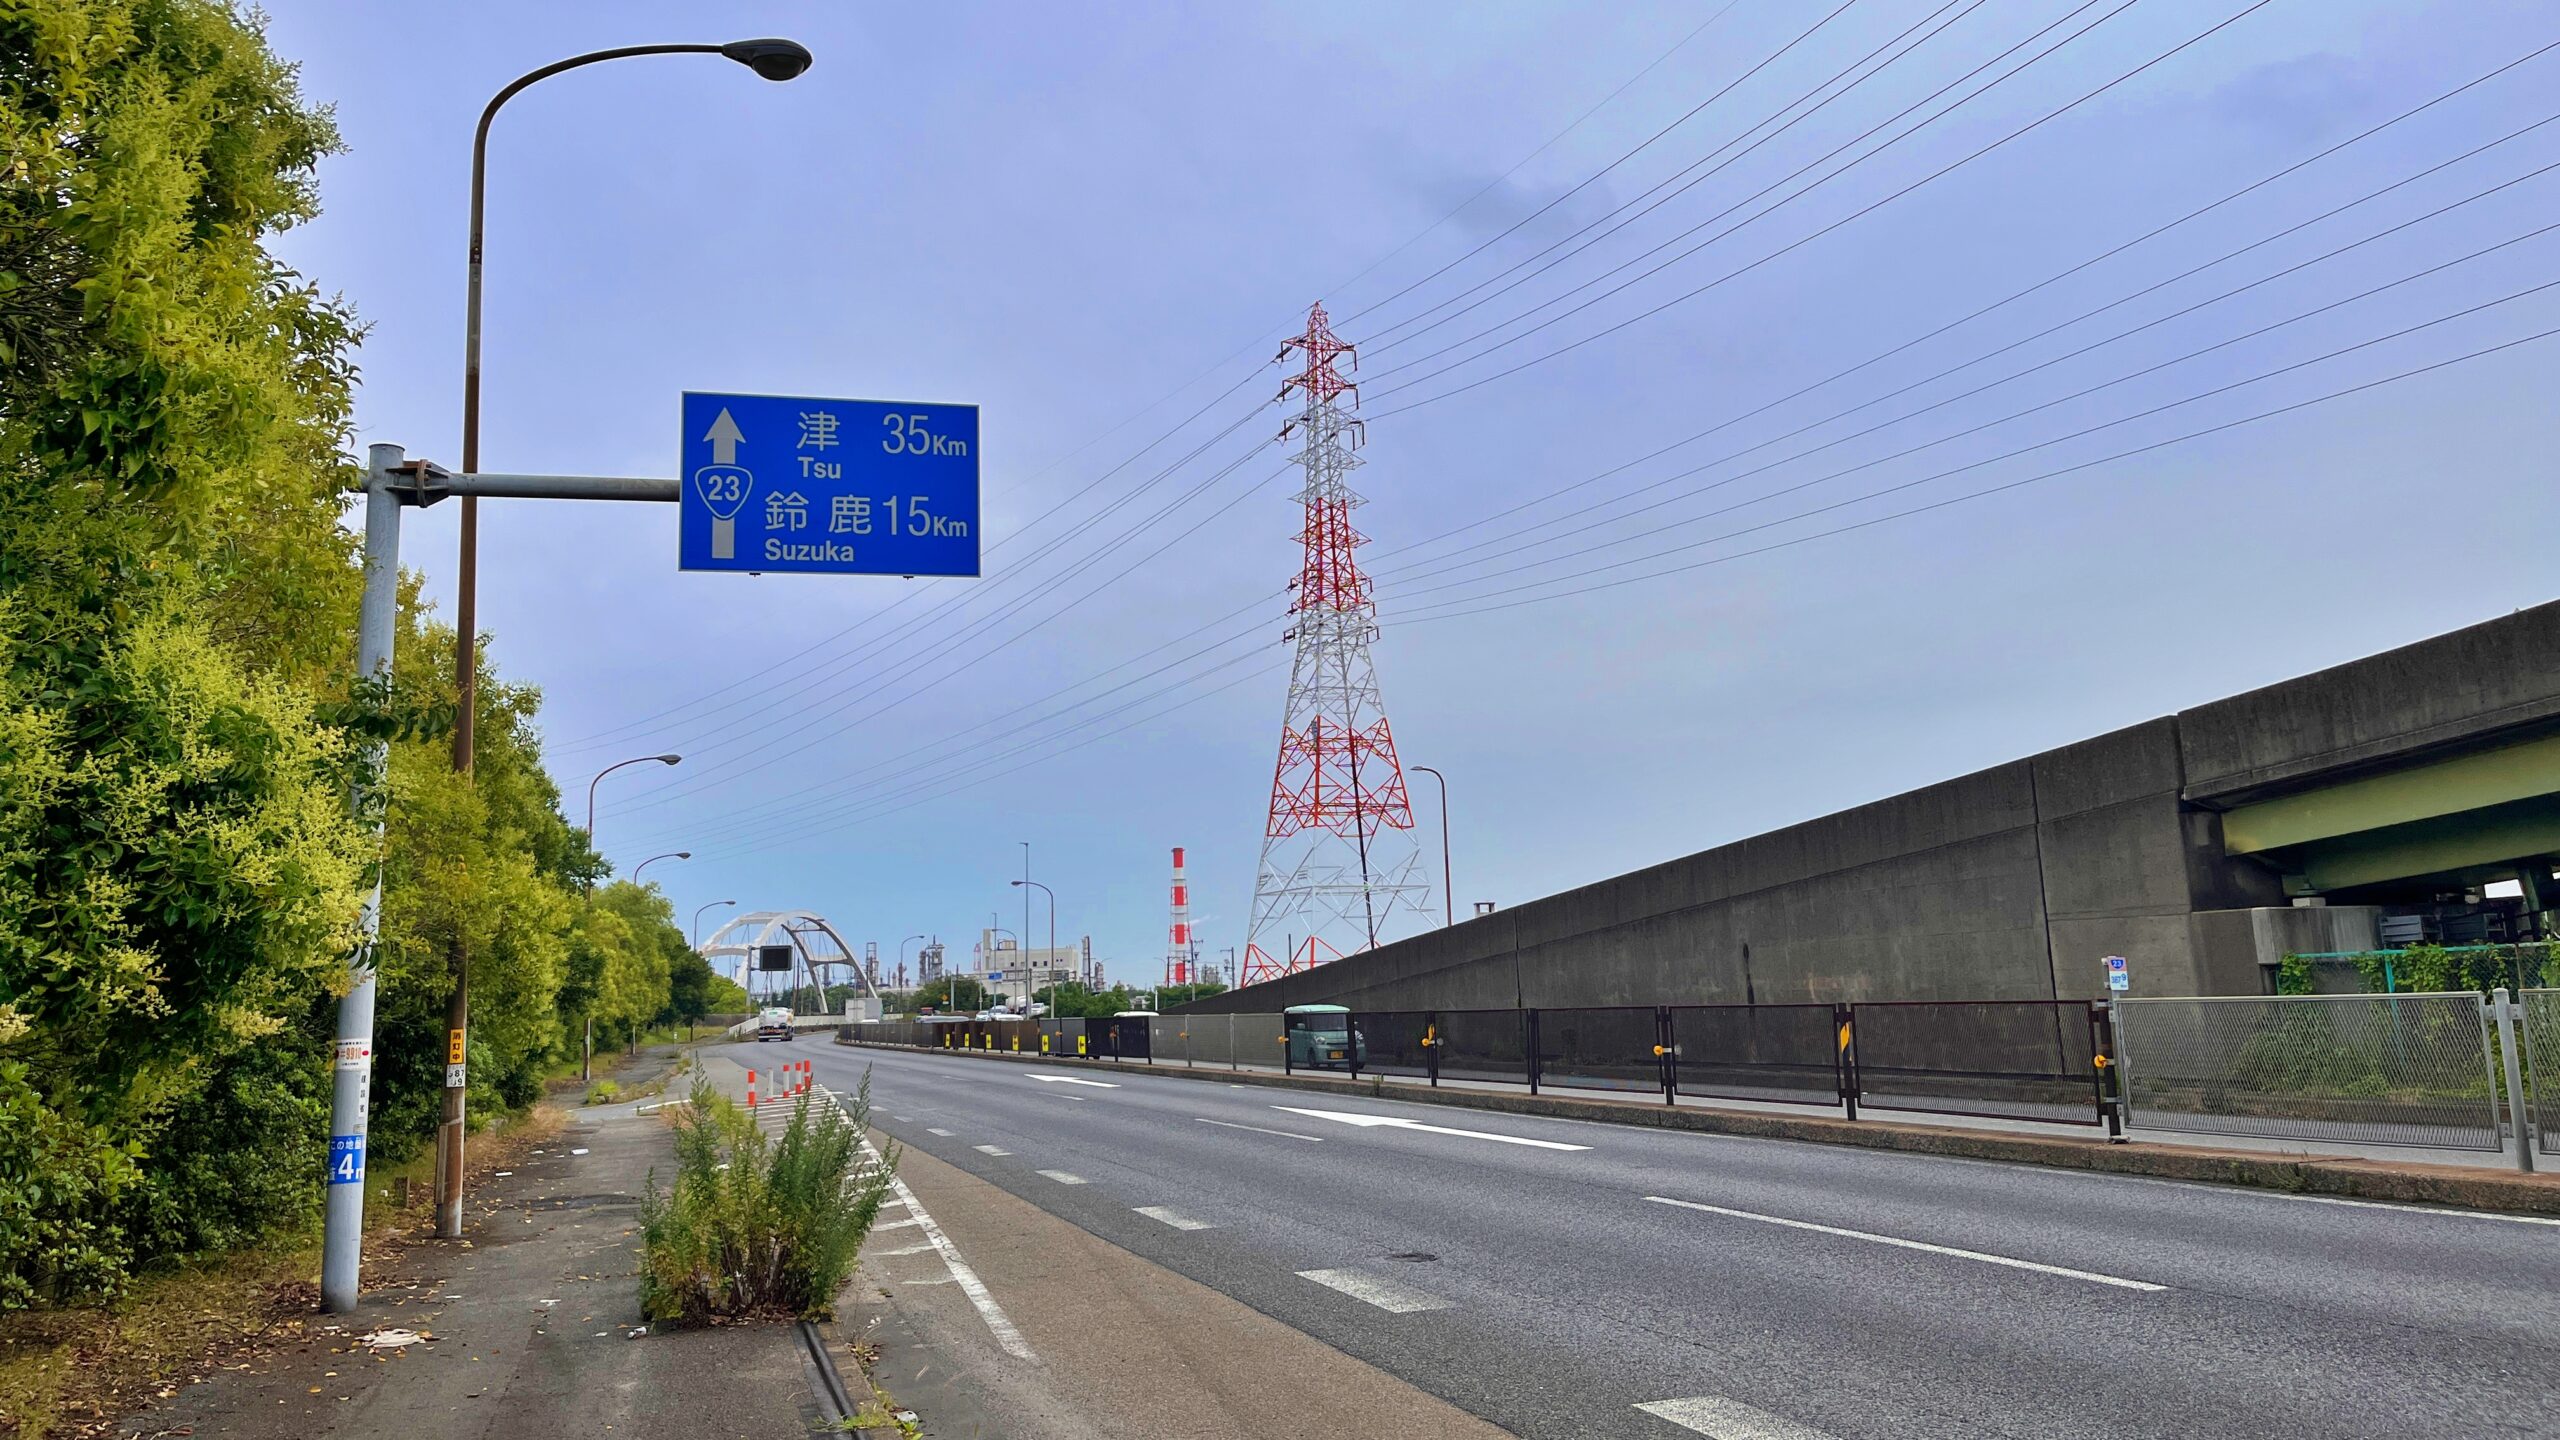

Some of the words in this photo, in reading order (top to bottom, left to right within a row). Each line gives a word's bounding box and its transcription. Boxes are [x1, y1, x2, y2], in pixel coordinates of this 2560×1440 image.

[796, 410, 841, 451] 津
[797, 456, 842, 479] Tsu
[708, 474, 741, 501] 23
[765, 490, 872, 535] 鈴鹿
[764, 538, 855, 562] Suzuka
